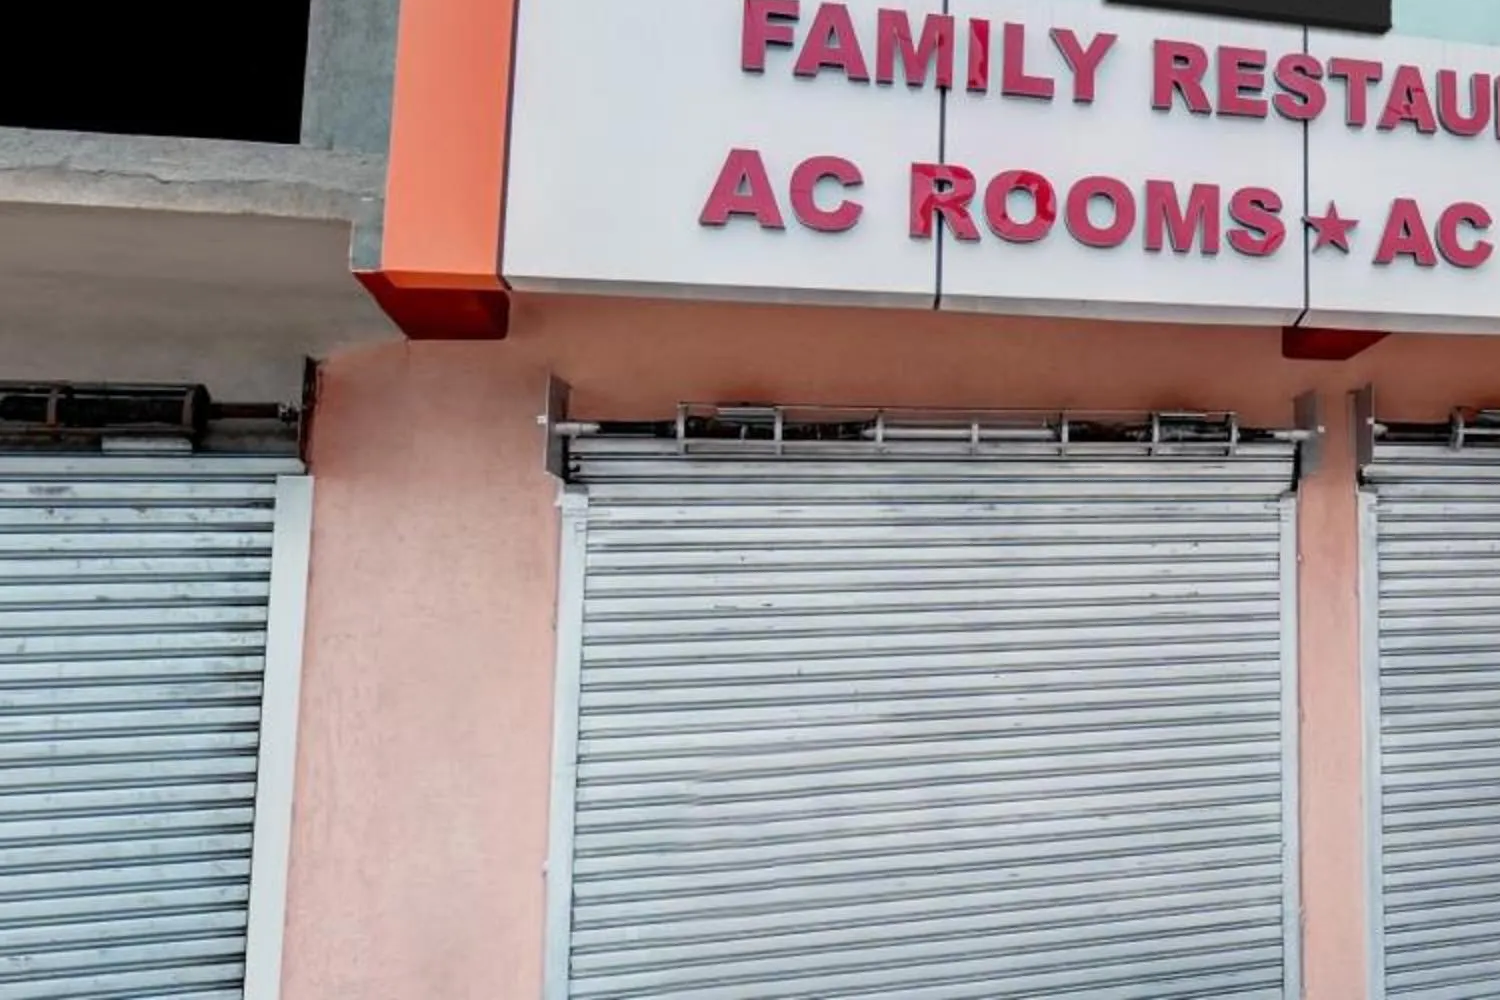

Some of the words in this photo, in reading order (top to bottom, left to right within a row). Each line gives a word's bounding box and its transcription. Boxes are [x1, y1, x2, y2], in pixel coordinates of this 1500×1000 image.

[698, 147, 865, 233] AC
[908, 160, 1286, 258] ROOMS
[1371, 197, 1495, 269] AC
